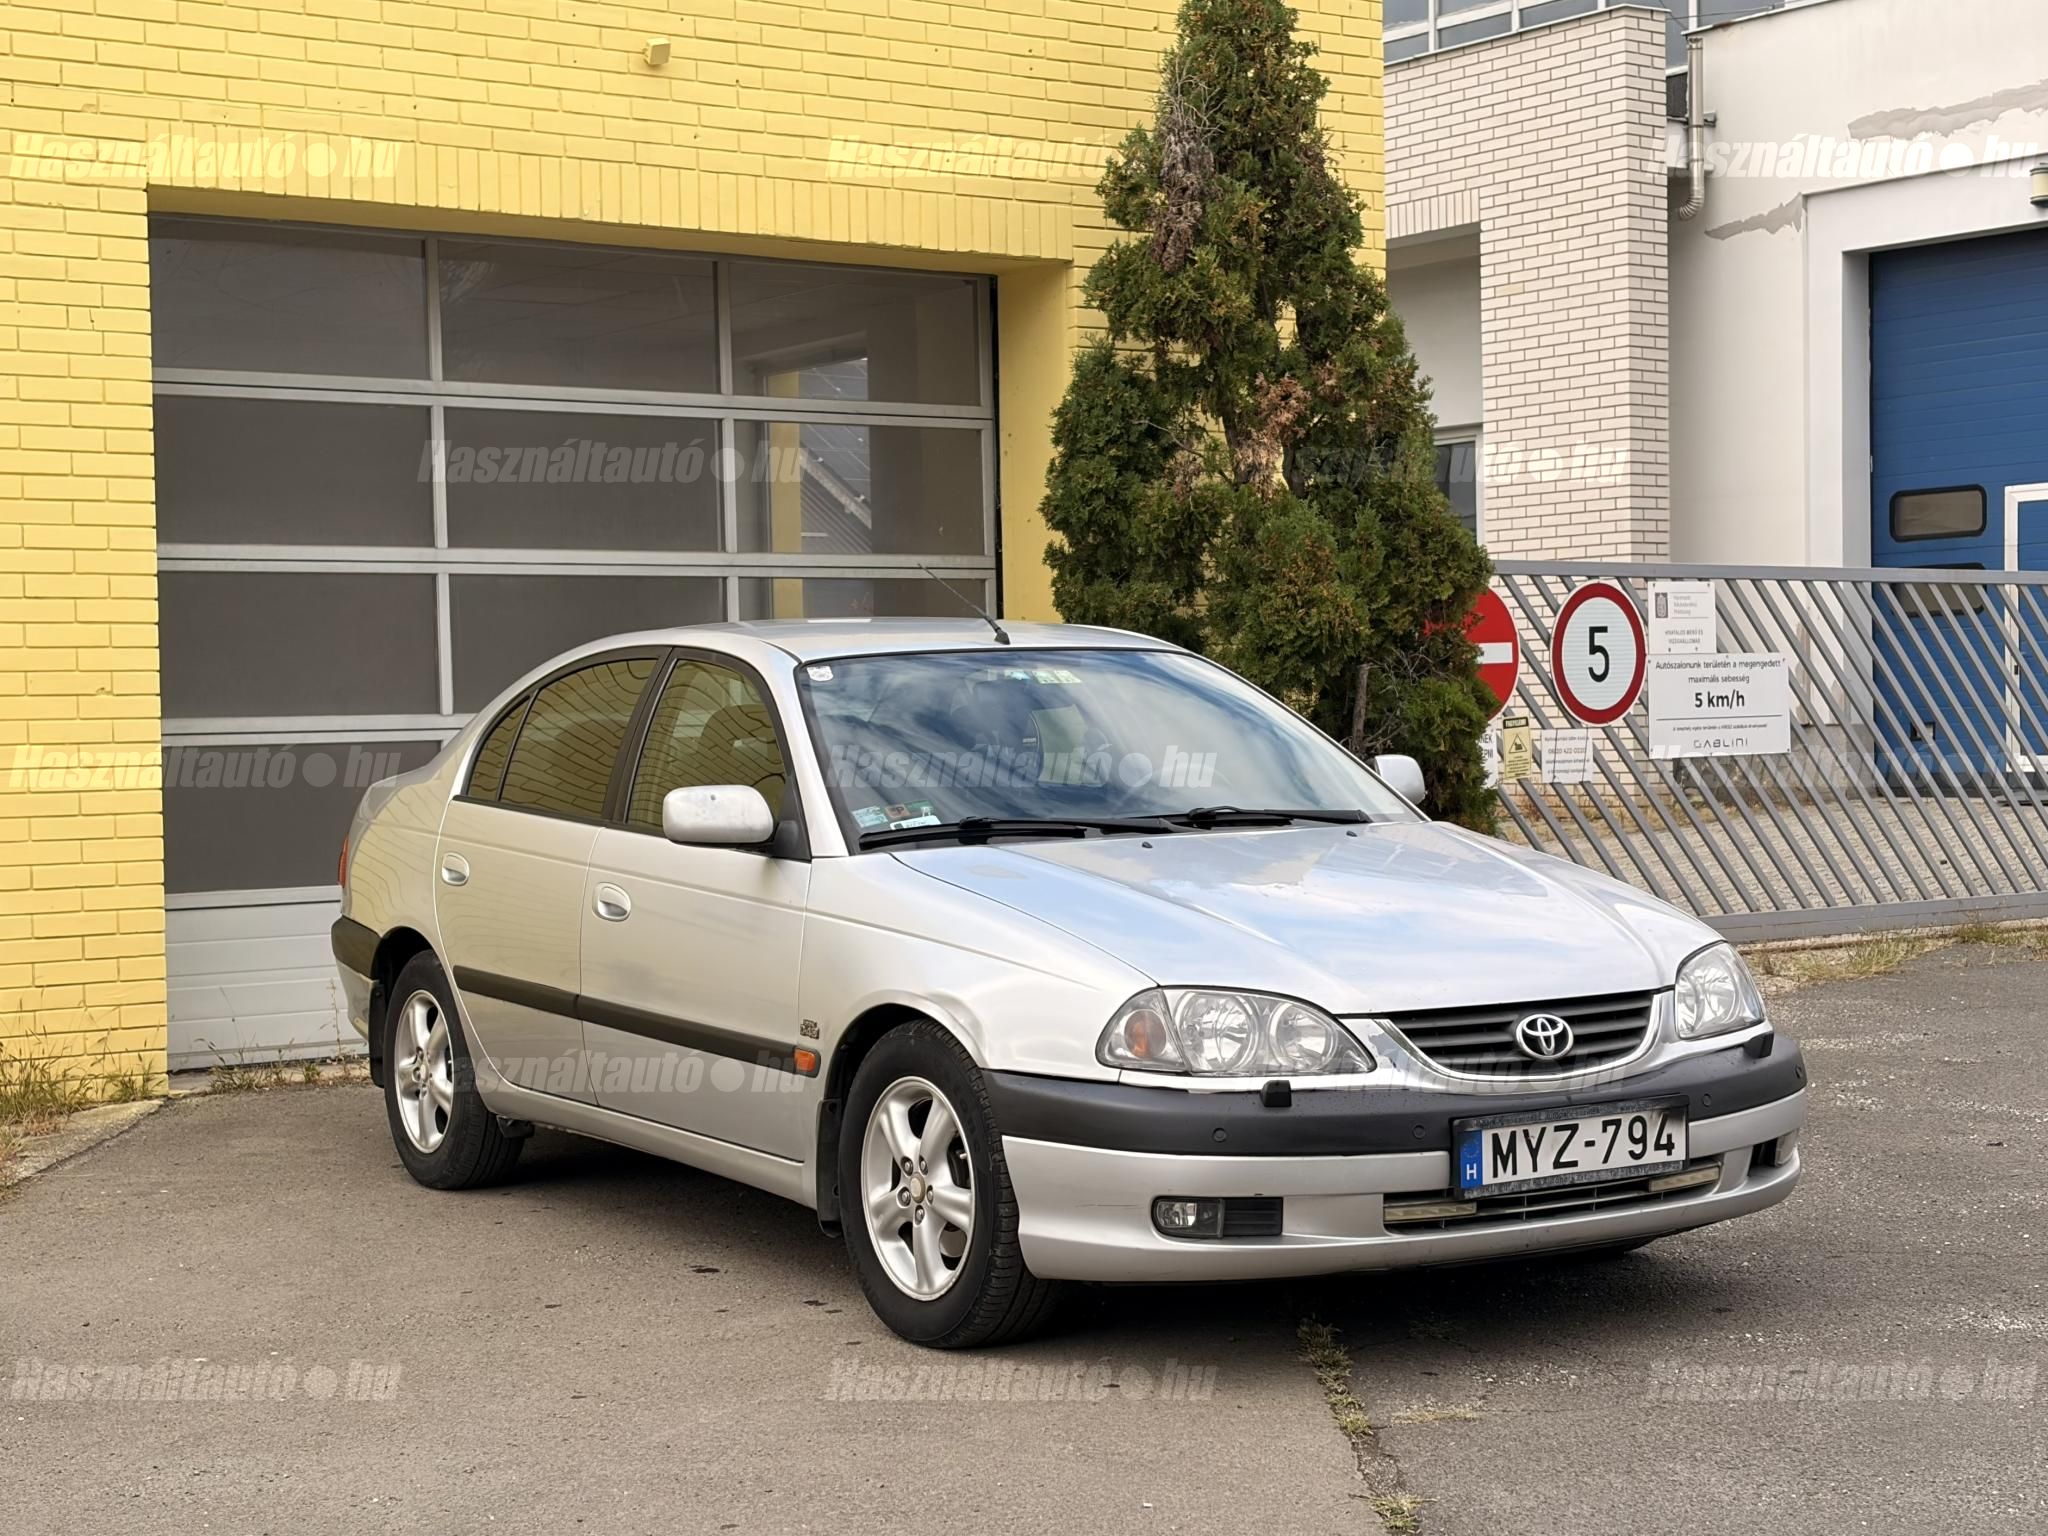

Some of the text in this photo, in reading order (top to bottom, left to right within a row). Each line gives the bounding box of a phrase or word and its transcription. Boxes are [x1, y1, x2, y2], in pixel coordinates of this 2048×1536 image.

[1587, 625, 1610, 683] 5
[1688, 675, 1750, 684] maximális sebesség
[1694, 689, 1745, 709] 5 km/h
[1693, 737, 1748, 749] GABLINI
[1491, 1112, 1676, 1179] MYZ-794
[1466, 1163, 1477, 1181] H
